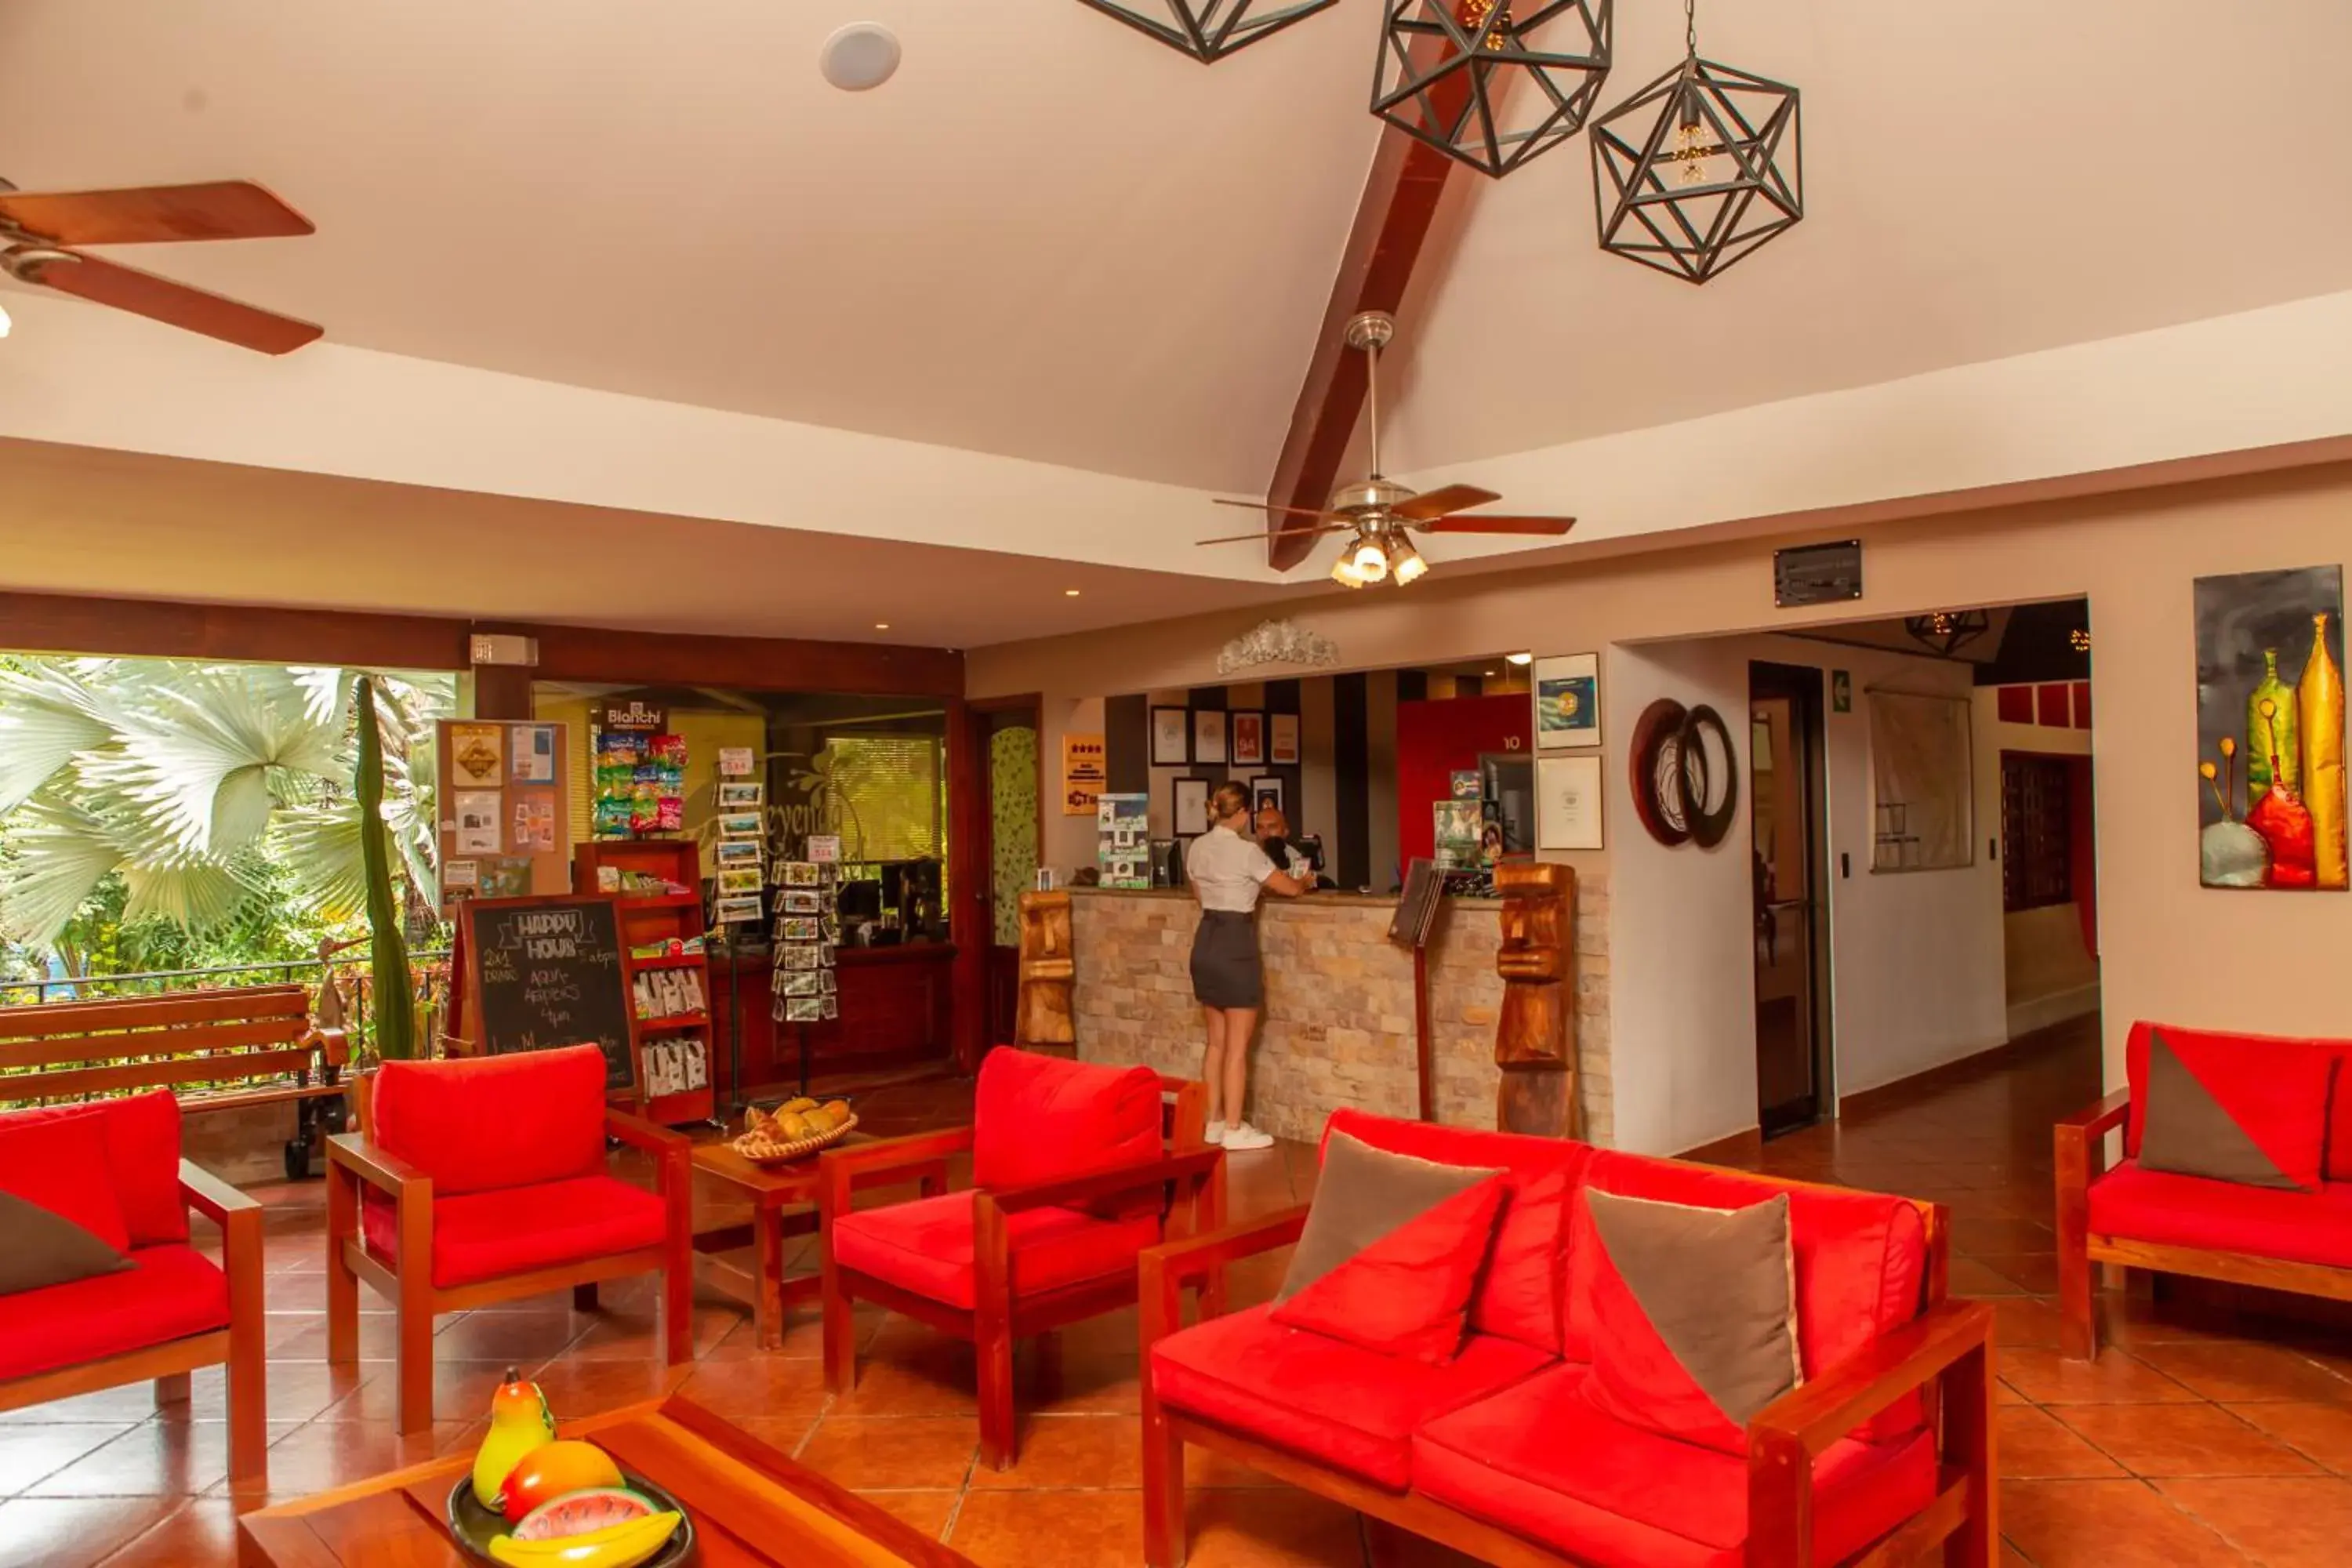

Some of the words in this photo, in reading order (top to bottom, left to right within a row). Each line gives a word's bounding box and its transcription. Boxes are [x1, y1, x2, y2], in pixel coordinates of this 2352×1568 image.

[608, 709, 661, 724] Bianchi
[517, 913, 577, 935] HAPPY
[526, 938, 577, 960] HOUR
